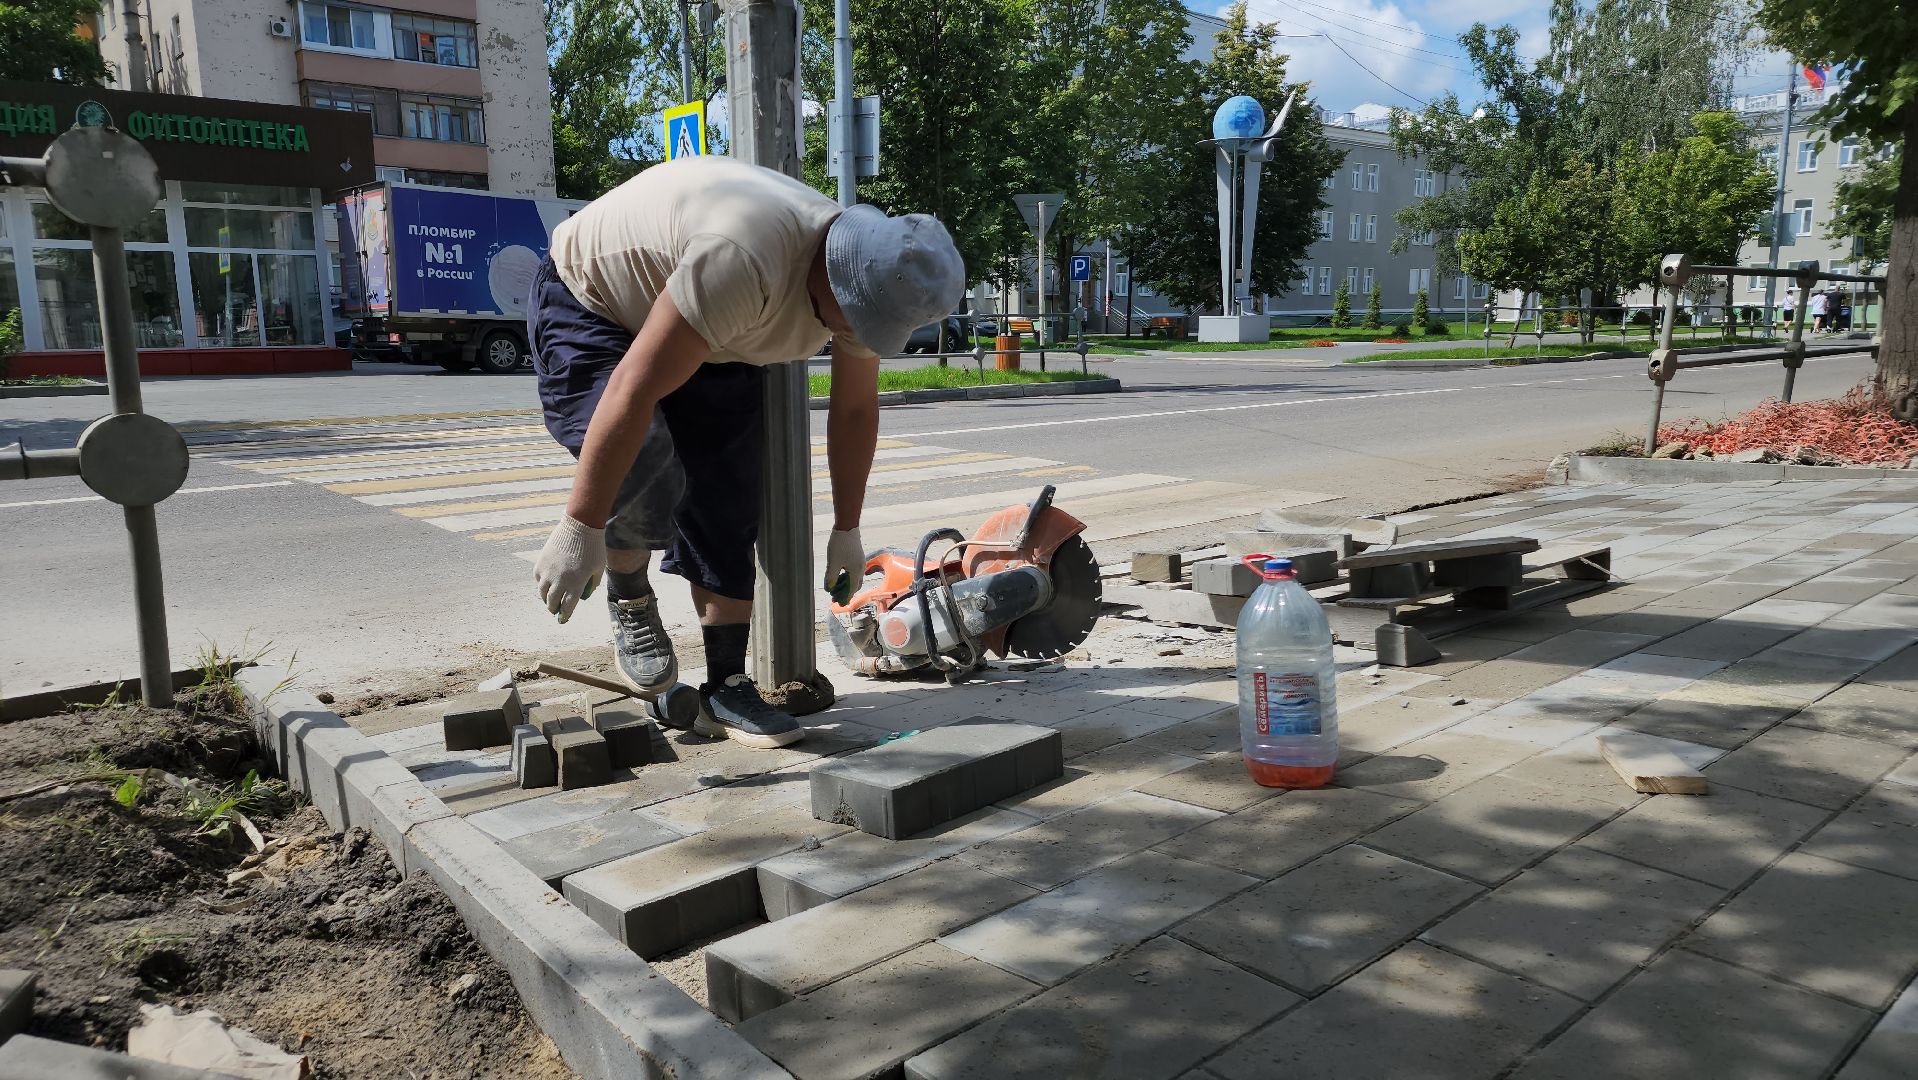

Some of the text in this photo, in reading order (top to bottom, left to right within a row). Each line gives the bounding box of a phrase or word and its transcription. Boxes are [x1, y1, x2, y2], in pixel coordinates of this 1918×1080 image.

[128, 111, 310, 152] ФИТОАПТЕКА
[408, 224, 476, 240] ПЛОМБИР
[425, 241, 463, 265] №1
[416, 269, 425, 278] в
[1074, 259, 1086, 278] P
